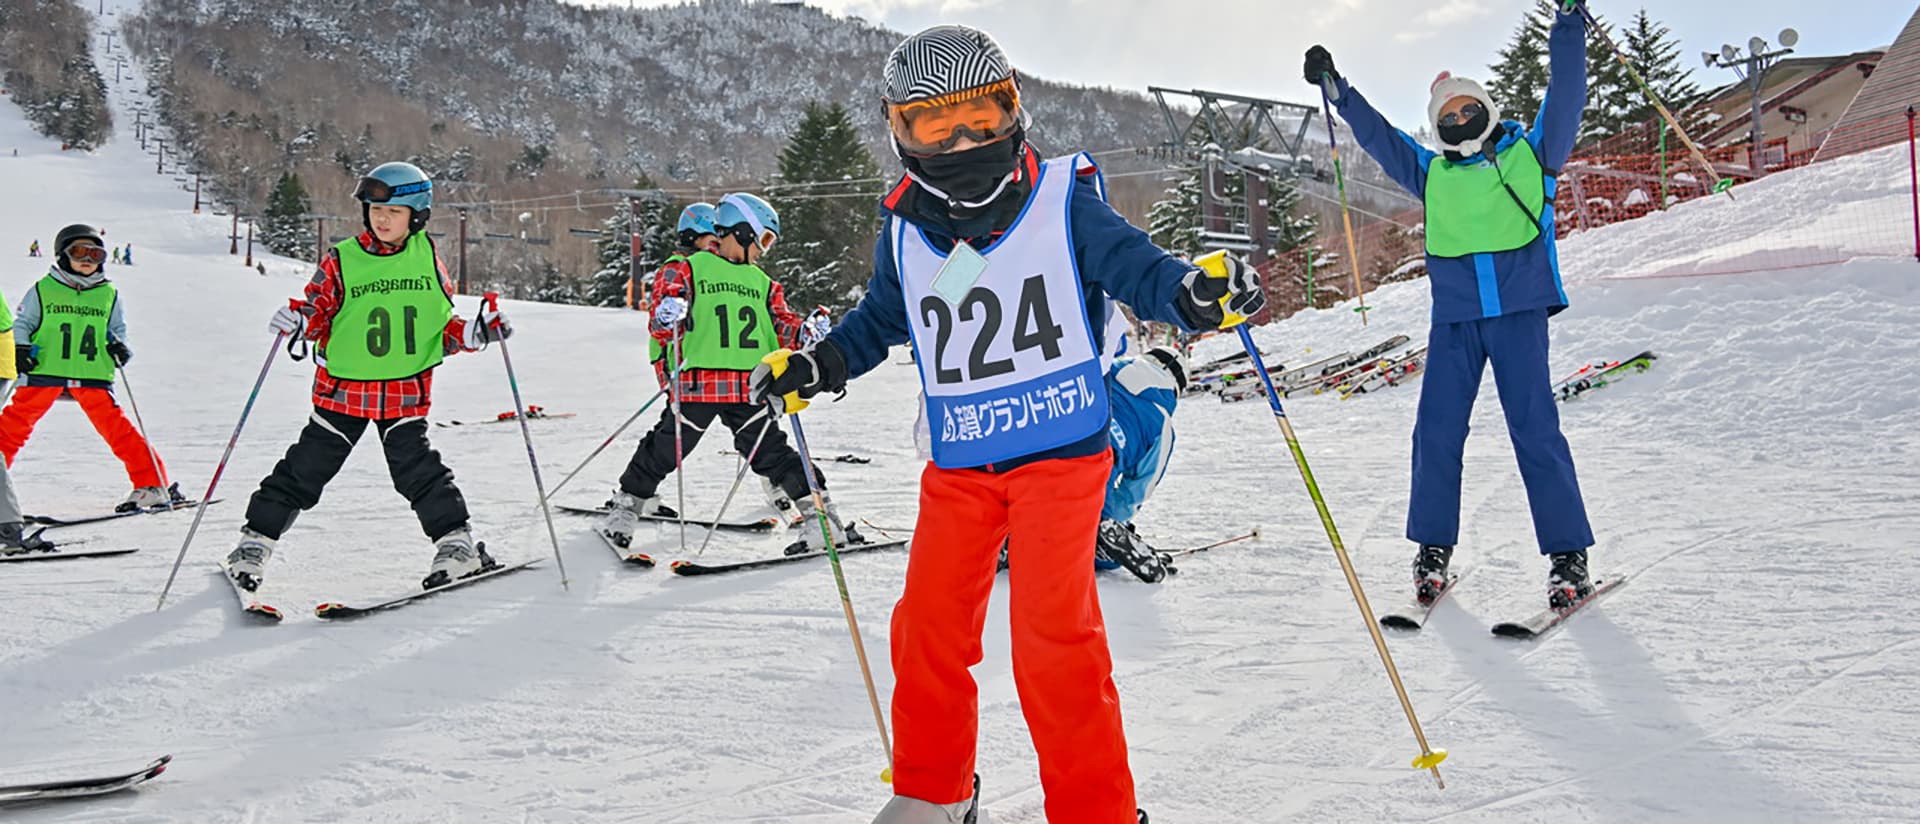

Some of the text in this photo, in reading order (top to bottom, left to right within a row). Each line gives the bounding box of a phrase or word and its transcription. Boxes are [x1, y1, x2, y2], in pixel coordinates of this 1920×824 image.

[60, 322, 98, 361] 14
[714, 304, 759, 349] 12
[920, 274, 1063, 384] 224
